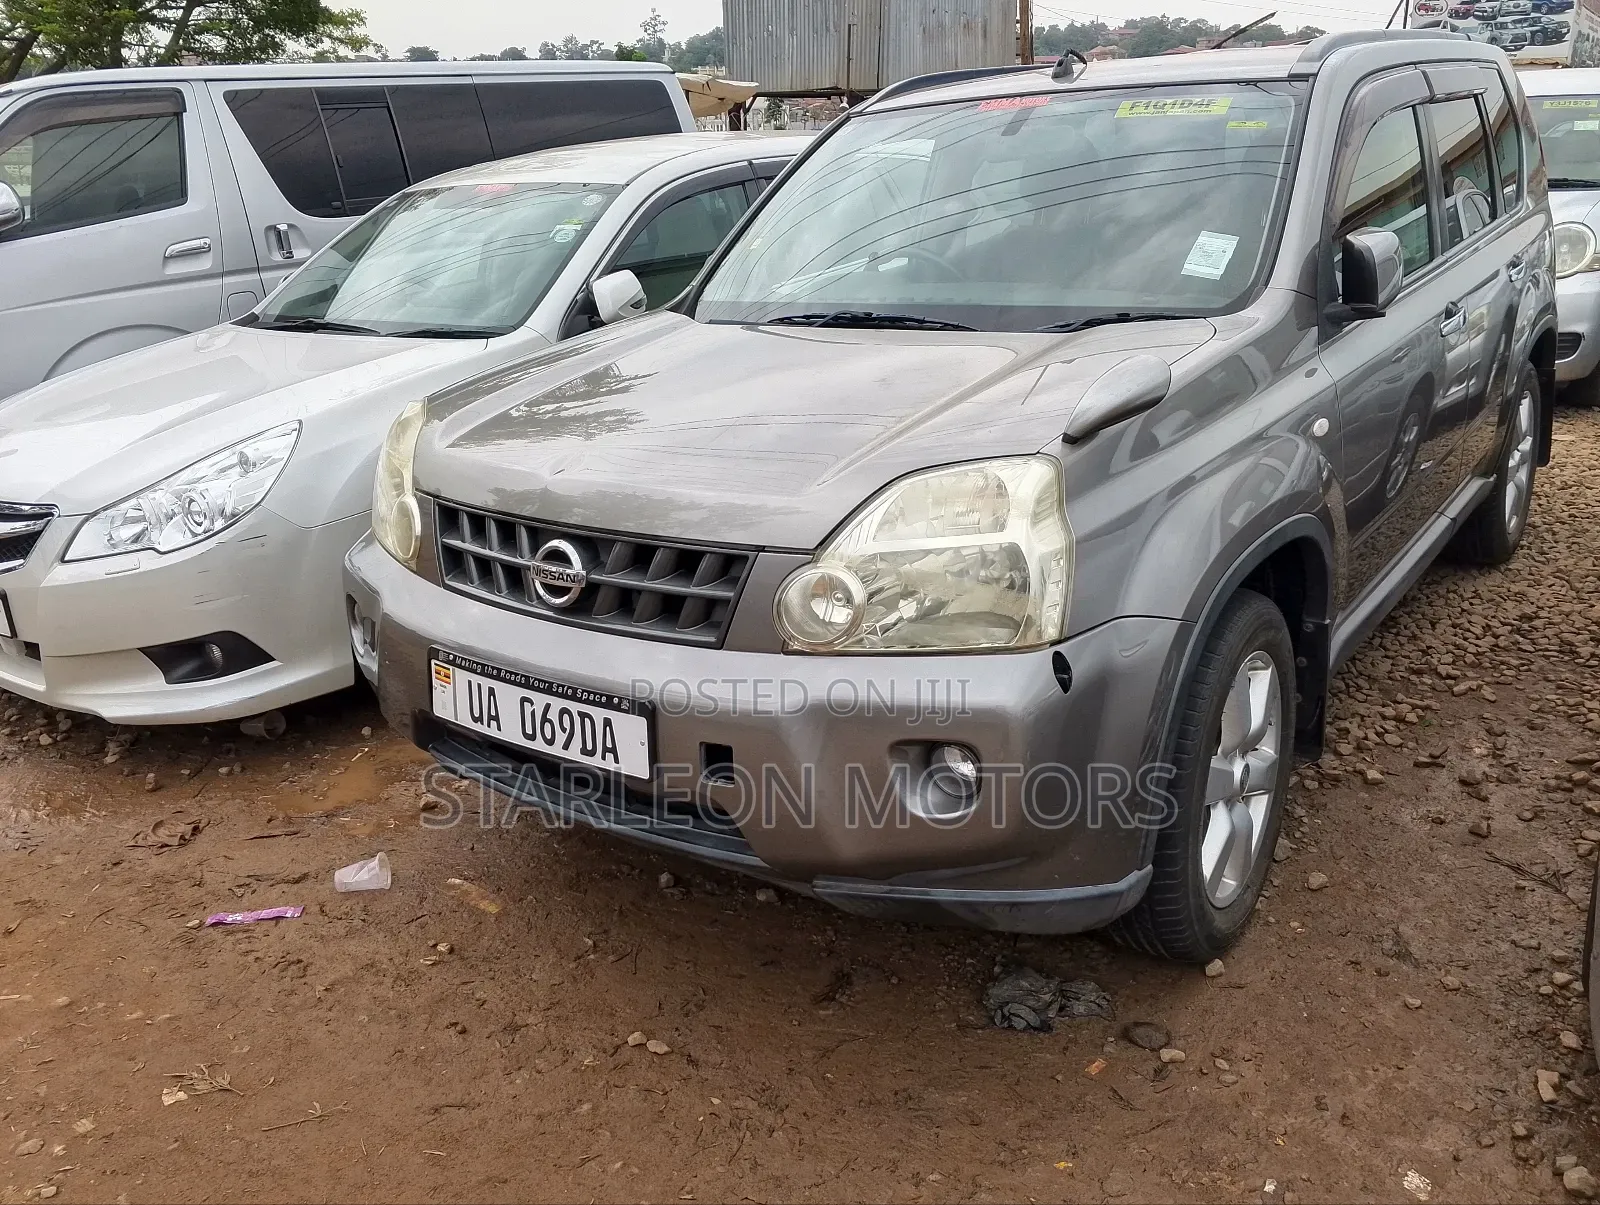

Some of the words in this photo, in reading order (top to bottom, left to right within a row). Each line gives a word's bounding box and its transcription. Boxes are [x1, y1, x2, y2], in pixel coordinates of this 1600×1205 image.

[532, 564, 576, 584] NISSAN
[455, 656, 482, 673] Making
[484, 665, 498, 676] the
[500, 669, 526, 684] Roads
[529, 677, 549, 690] Your
[552, 683, 573, 696] Safe
[576, 689, 607, 703] Space
[467, 679, 502, 732] UA
[519, 695, 620, 765] 069DA
